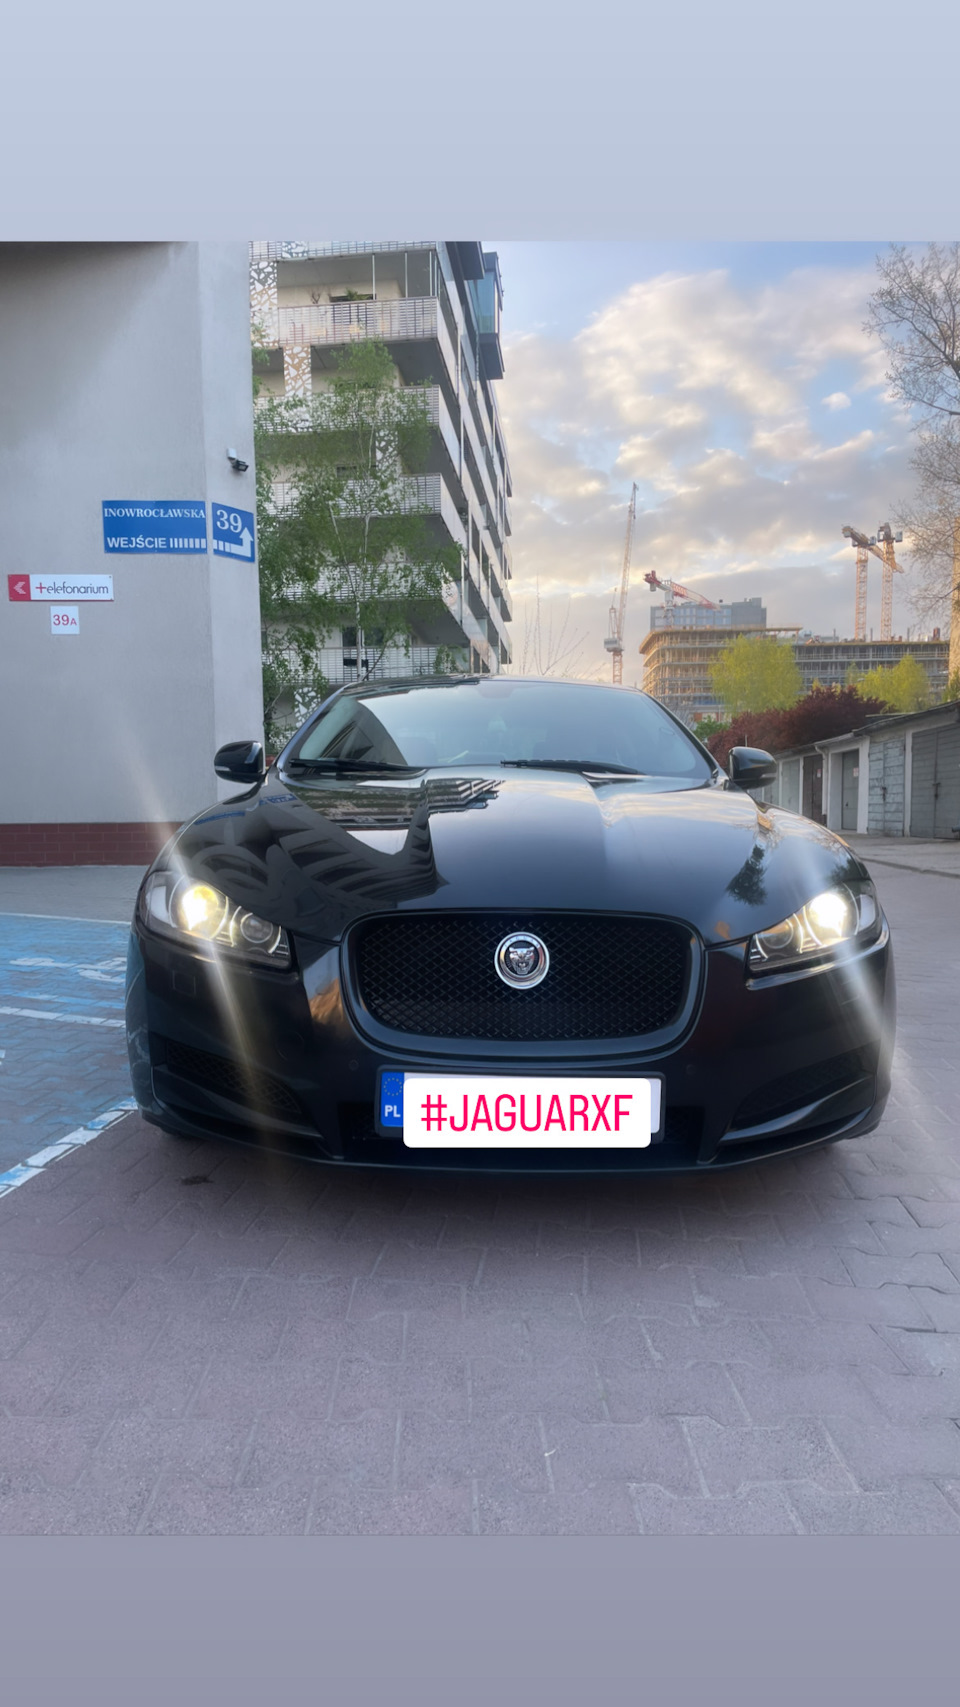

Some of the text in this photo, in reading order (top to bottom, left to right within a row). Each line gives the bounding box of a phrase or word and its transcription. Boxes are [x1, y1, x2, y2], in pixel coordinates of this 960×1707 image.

[104, 508, 206, 518] INOWROCŁAWSKA
[216, 509, 242, 533] 39
[107, 535, 167, 548] WEJŚCIE
[53, 614, 77, 626] 39A
[384, 1105, 401, 1118] PL
